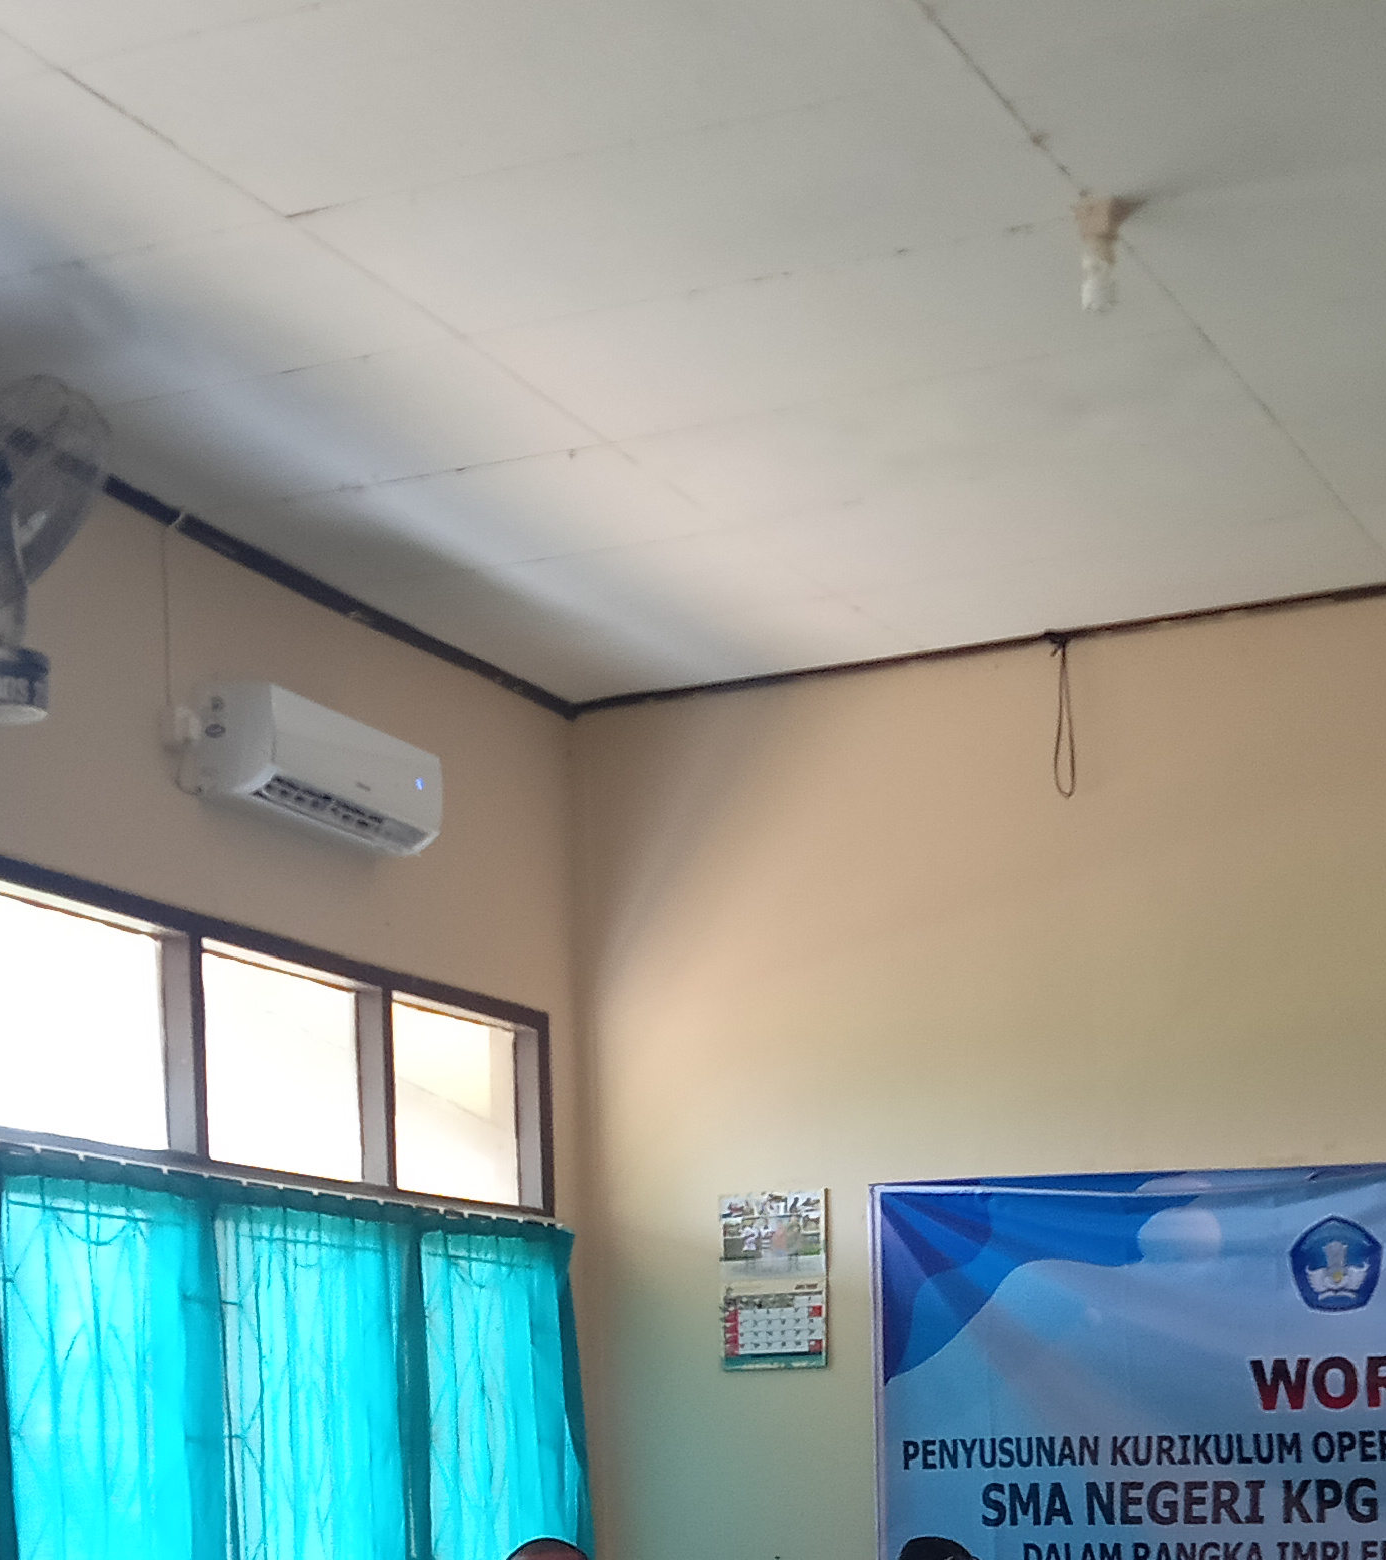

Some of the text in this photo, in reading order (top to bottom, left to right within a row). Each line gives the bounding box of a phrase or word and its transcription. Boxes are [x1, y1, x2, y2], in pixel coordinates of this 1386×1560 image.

[902, 1435, 1101, 1471] PENYUSUNAN
[1110, 1431, 1303, 1468] KURIKULUM
[980, 1481, 1074, 1528] SMA
[1086, 1479, 1265, 1527] NEGERI
[1282, 1476, 1379, 1526] KPG
